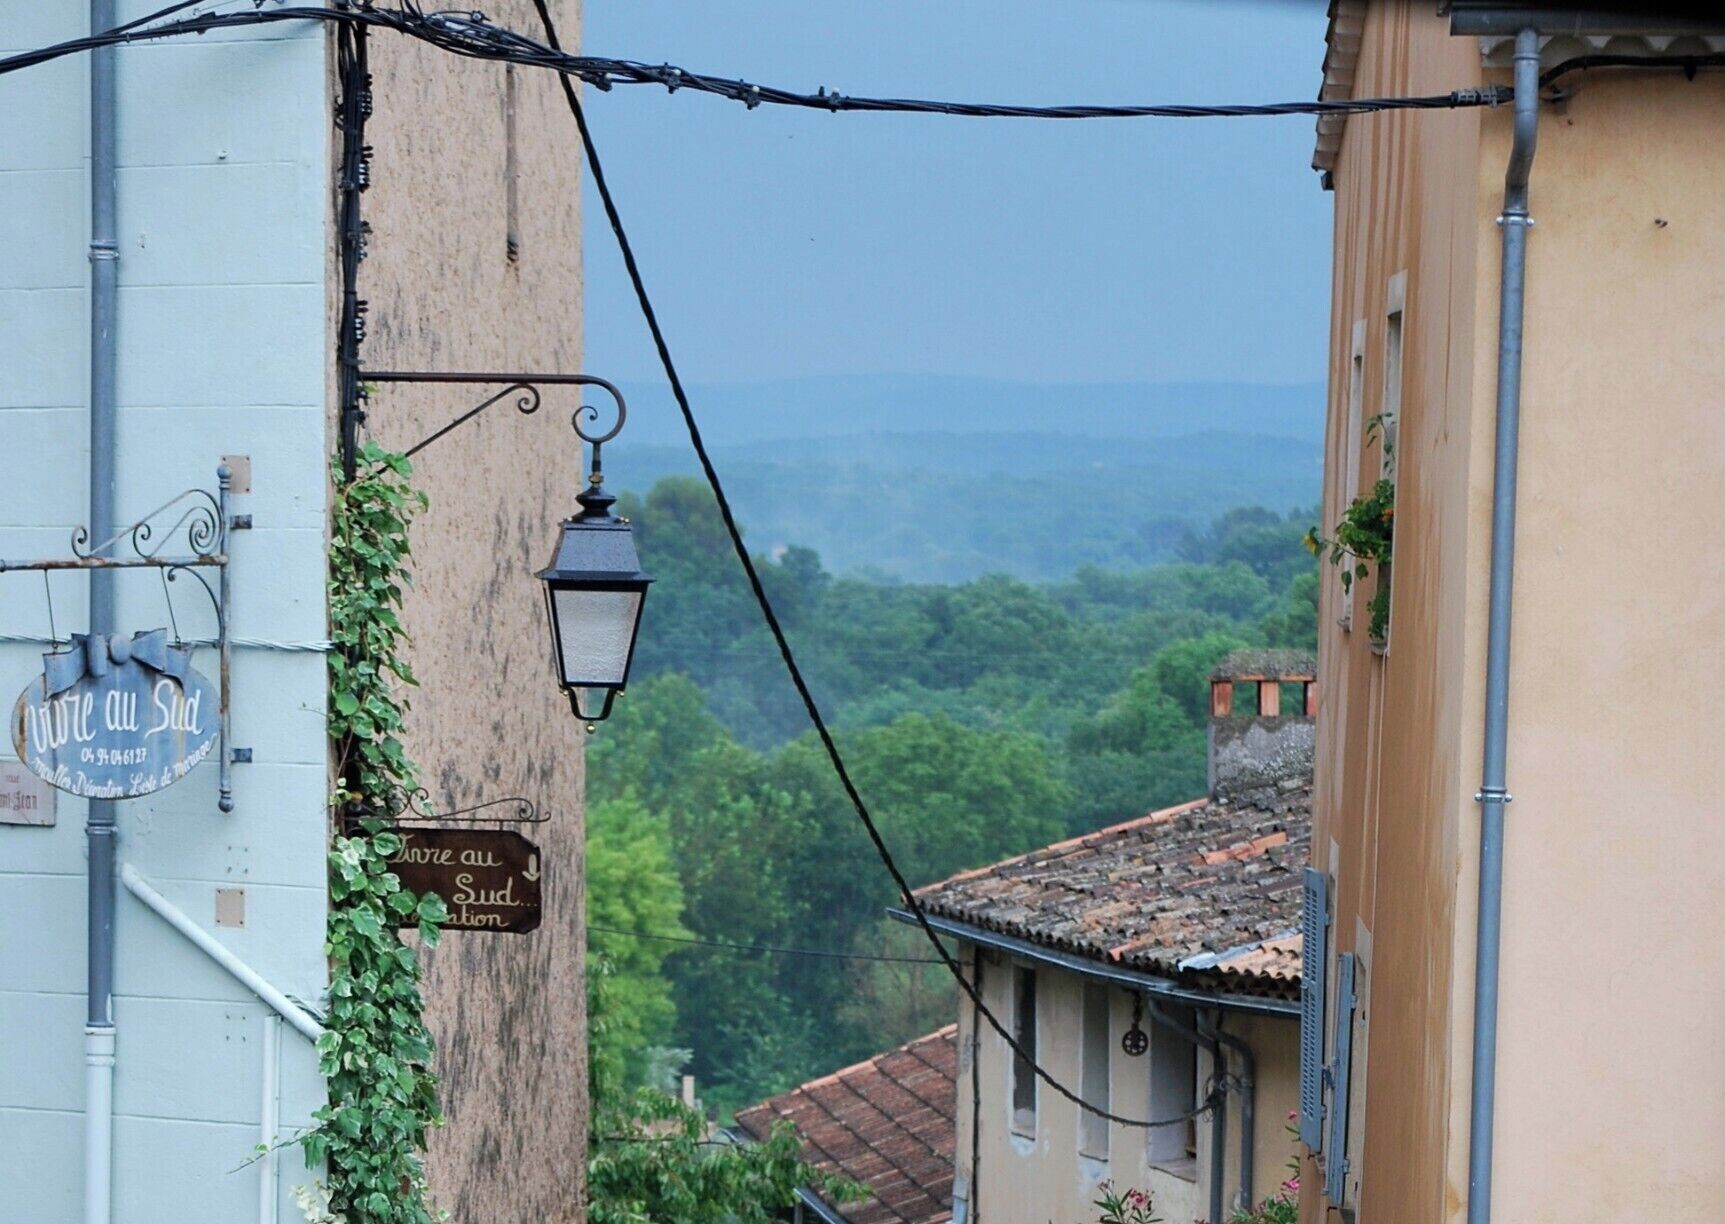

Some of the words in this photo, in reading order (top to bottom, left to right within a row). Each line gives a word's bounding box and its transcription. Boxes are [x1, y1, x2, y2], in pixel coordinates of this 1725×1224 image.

[25, 691, 97, 753] Vivre
[105, 689, 139, 732] au
[144, 679, 205, 738] Sud
[460, 849, 502, 867] au
